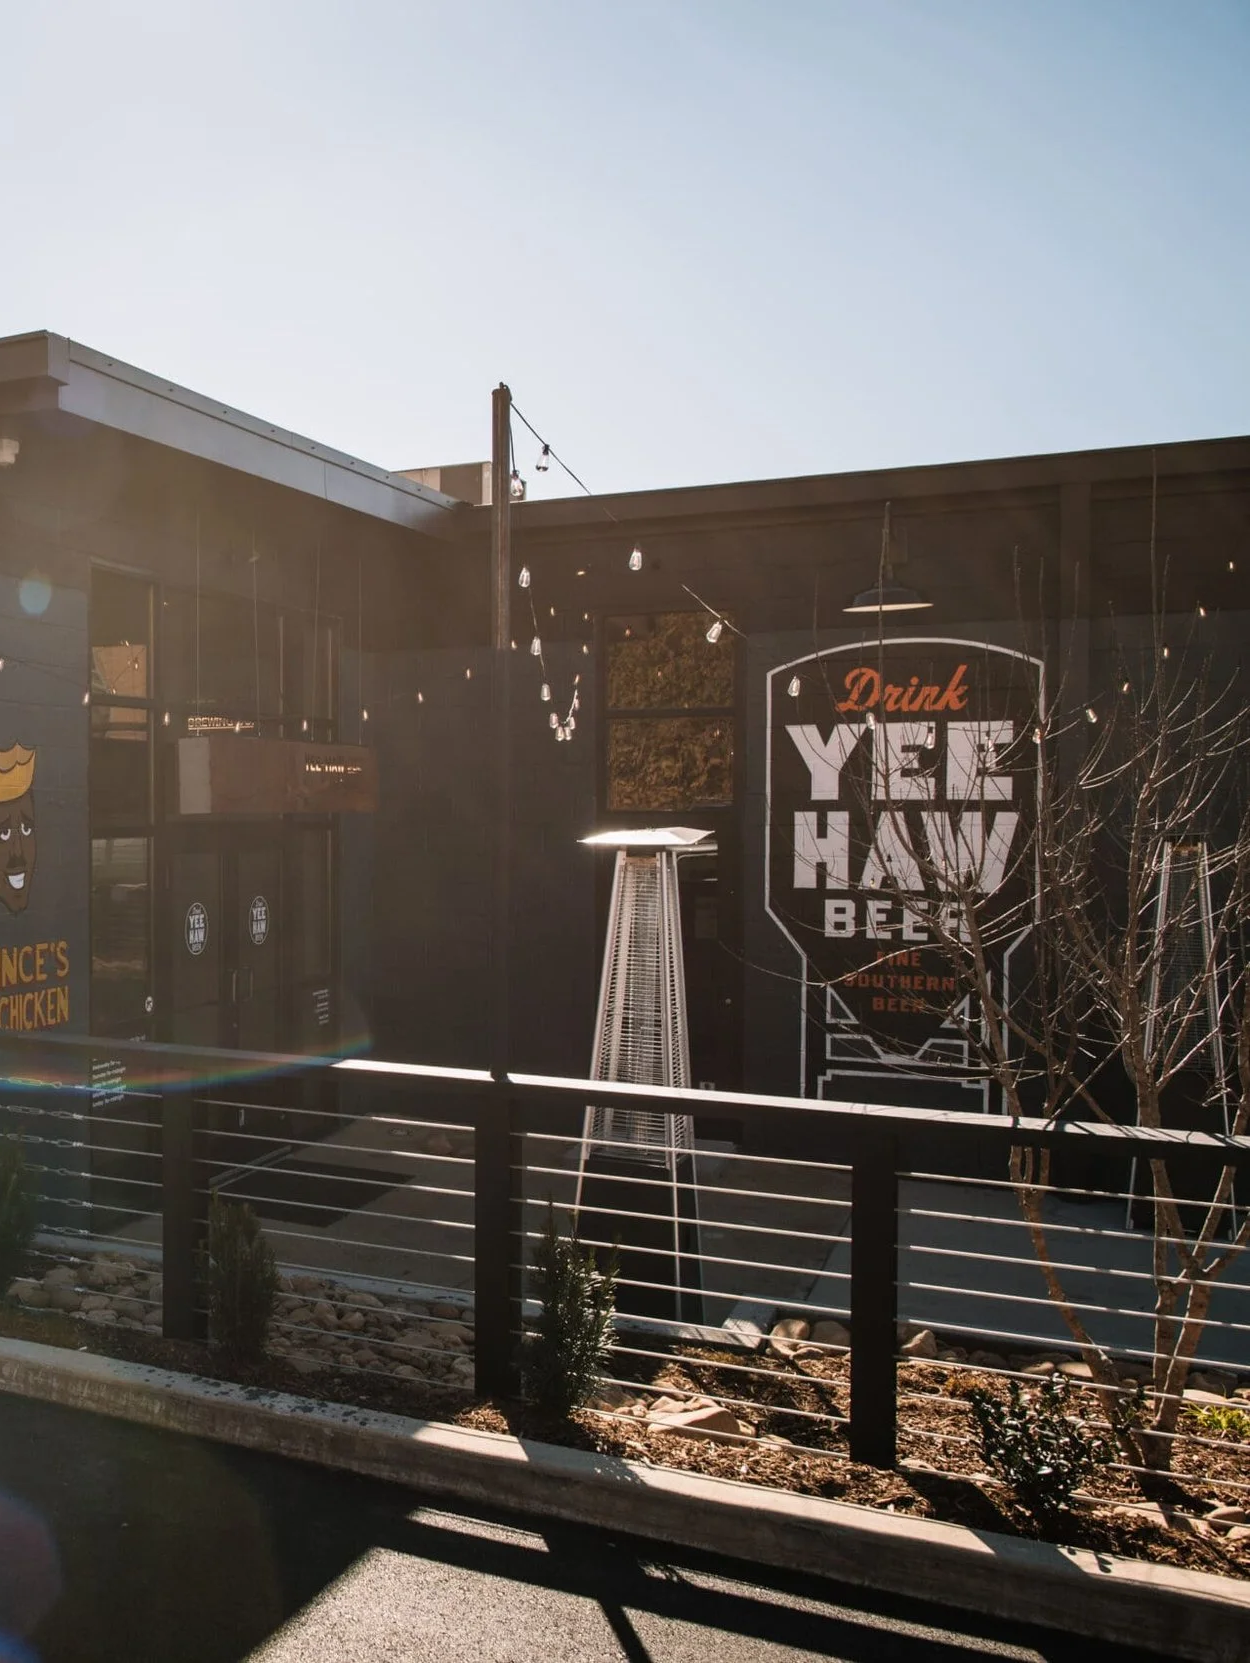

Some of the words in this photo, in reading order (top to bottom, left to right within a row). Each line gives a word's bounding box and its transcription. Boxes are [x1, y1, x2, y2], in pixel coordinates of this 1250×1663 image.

[835, 664, 968, 712] Drink
[784, 720, 1014, 801] YEE
[793, 811, 1019, 894] HAW
[189, 914, 205, 929] YEE
[824, 899, 974, 943] BEER
[876, 951, 921, 967] FINE
[844, 973, 956, 992] SOUTHERN
